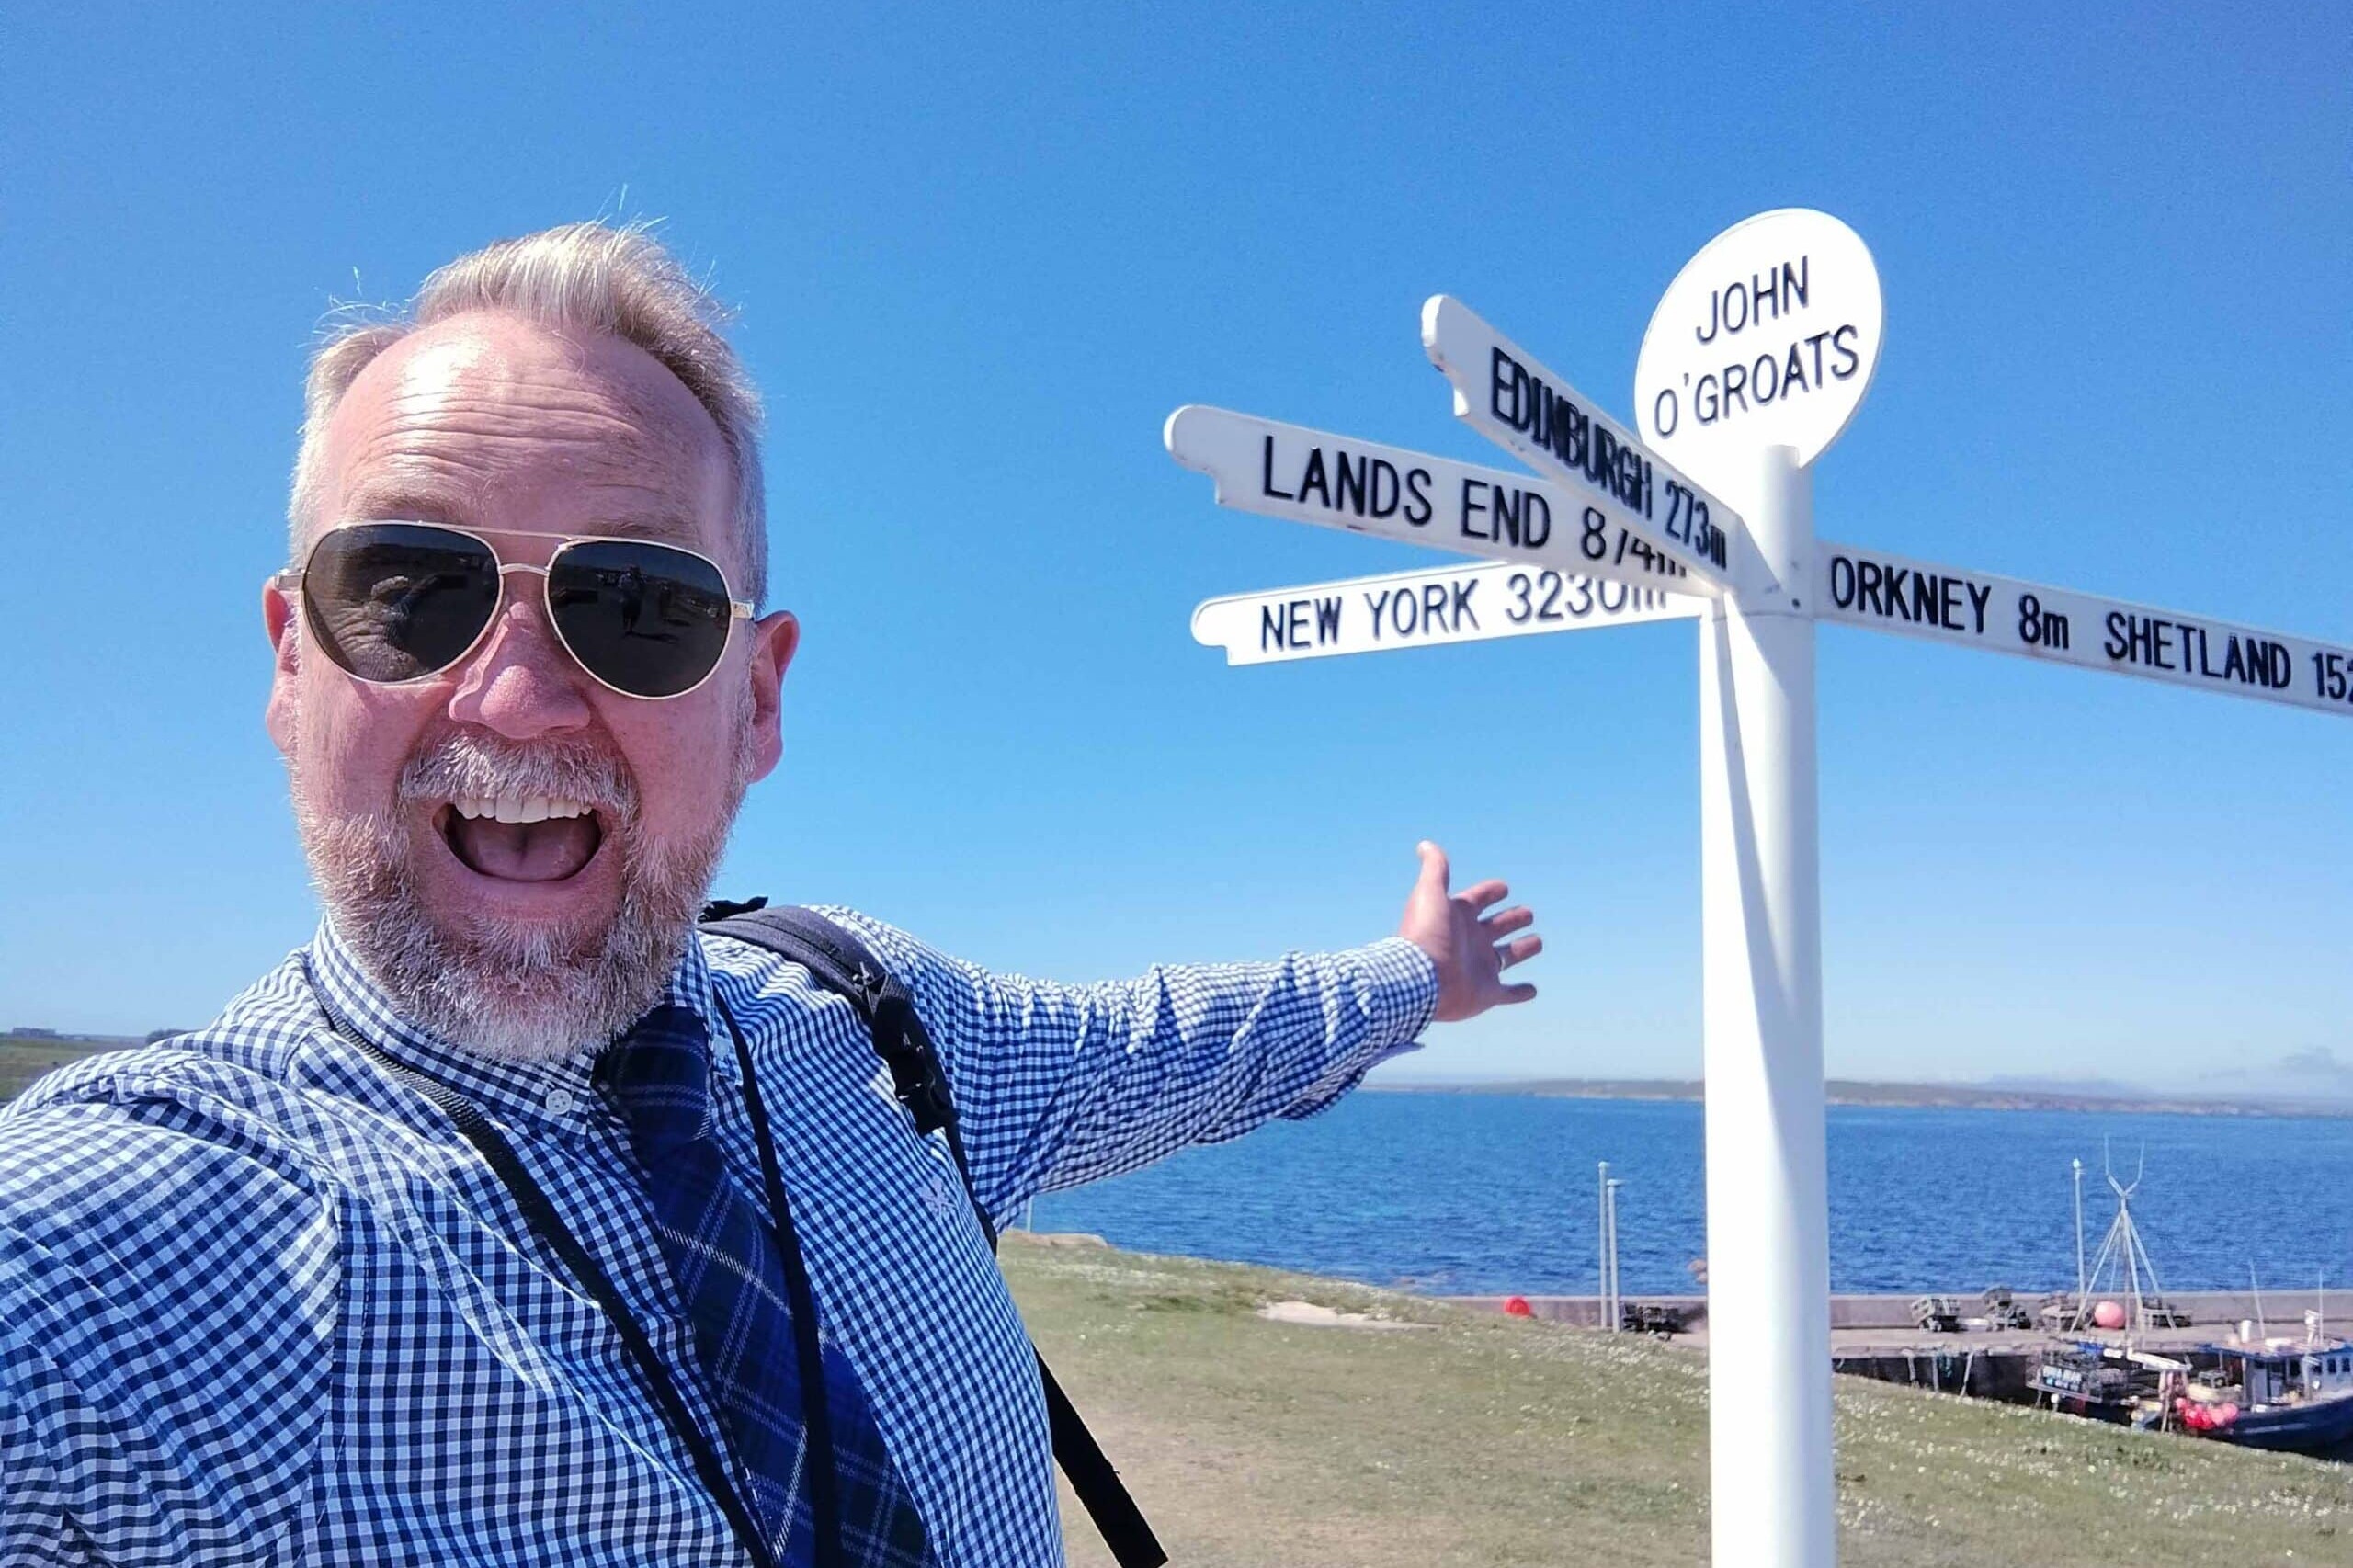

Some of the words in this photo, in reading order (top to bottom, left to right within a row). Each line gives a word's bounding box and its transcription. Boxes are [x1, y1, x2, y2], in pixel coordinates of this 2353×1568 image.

[1696, 255, 1809, 345] JOHN
[1654, 324, 1859, 438] O'GROATS
[1263, 435, 1433, 527] LANDS
[1461, 478, 1551, 550] END
[1492, 346, 1653, 520] EDINBURGH
[1665, 479, 1727, 572] 273m
[1261, 596, 1343, 653] NEW
[1364, 578, 1479, 642] YORK
[1831, 556, 1991, 634] ORKNEY
[2018, 594, 2070, 649] 8m
[2105, 612, 2292, 688] SHETLAND
